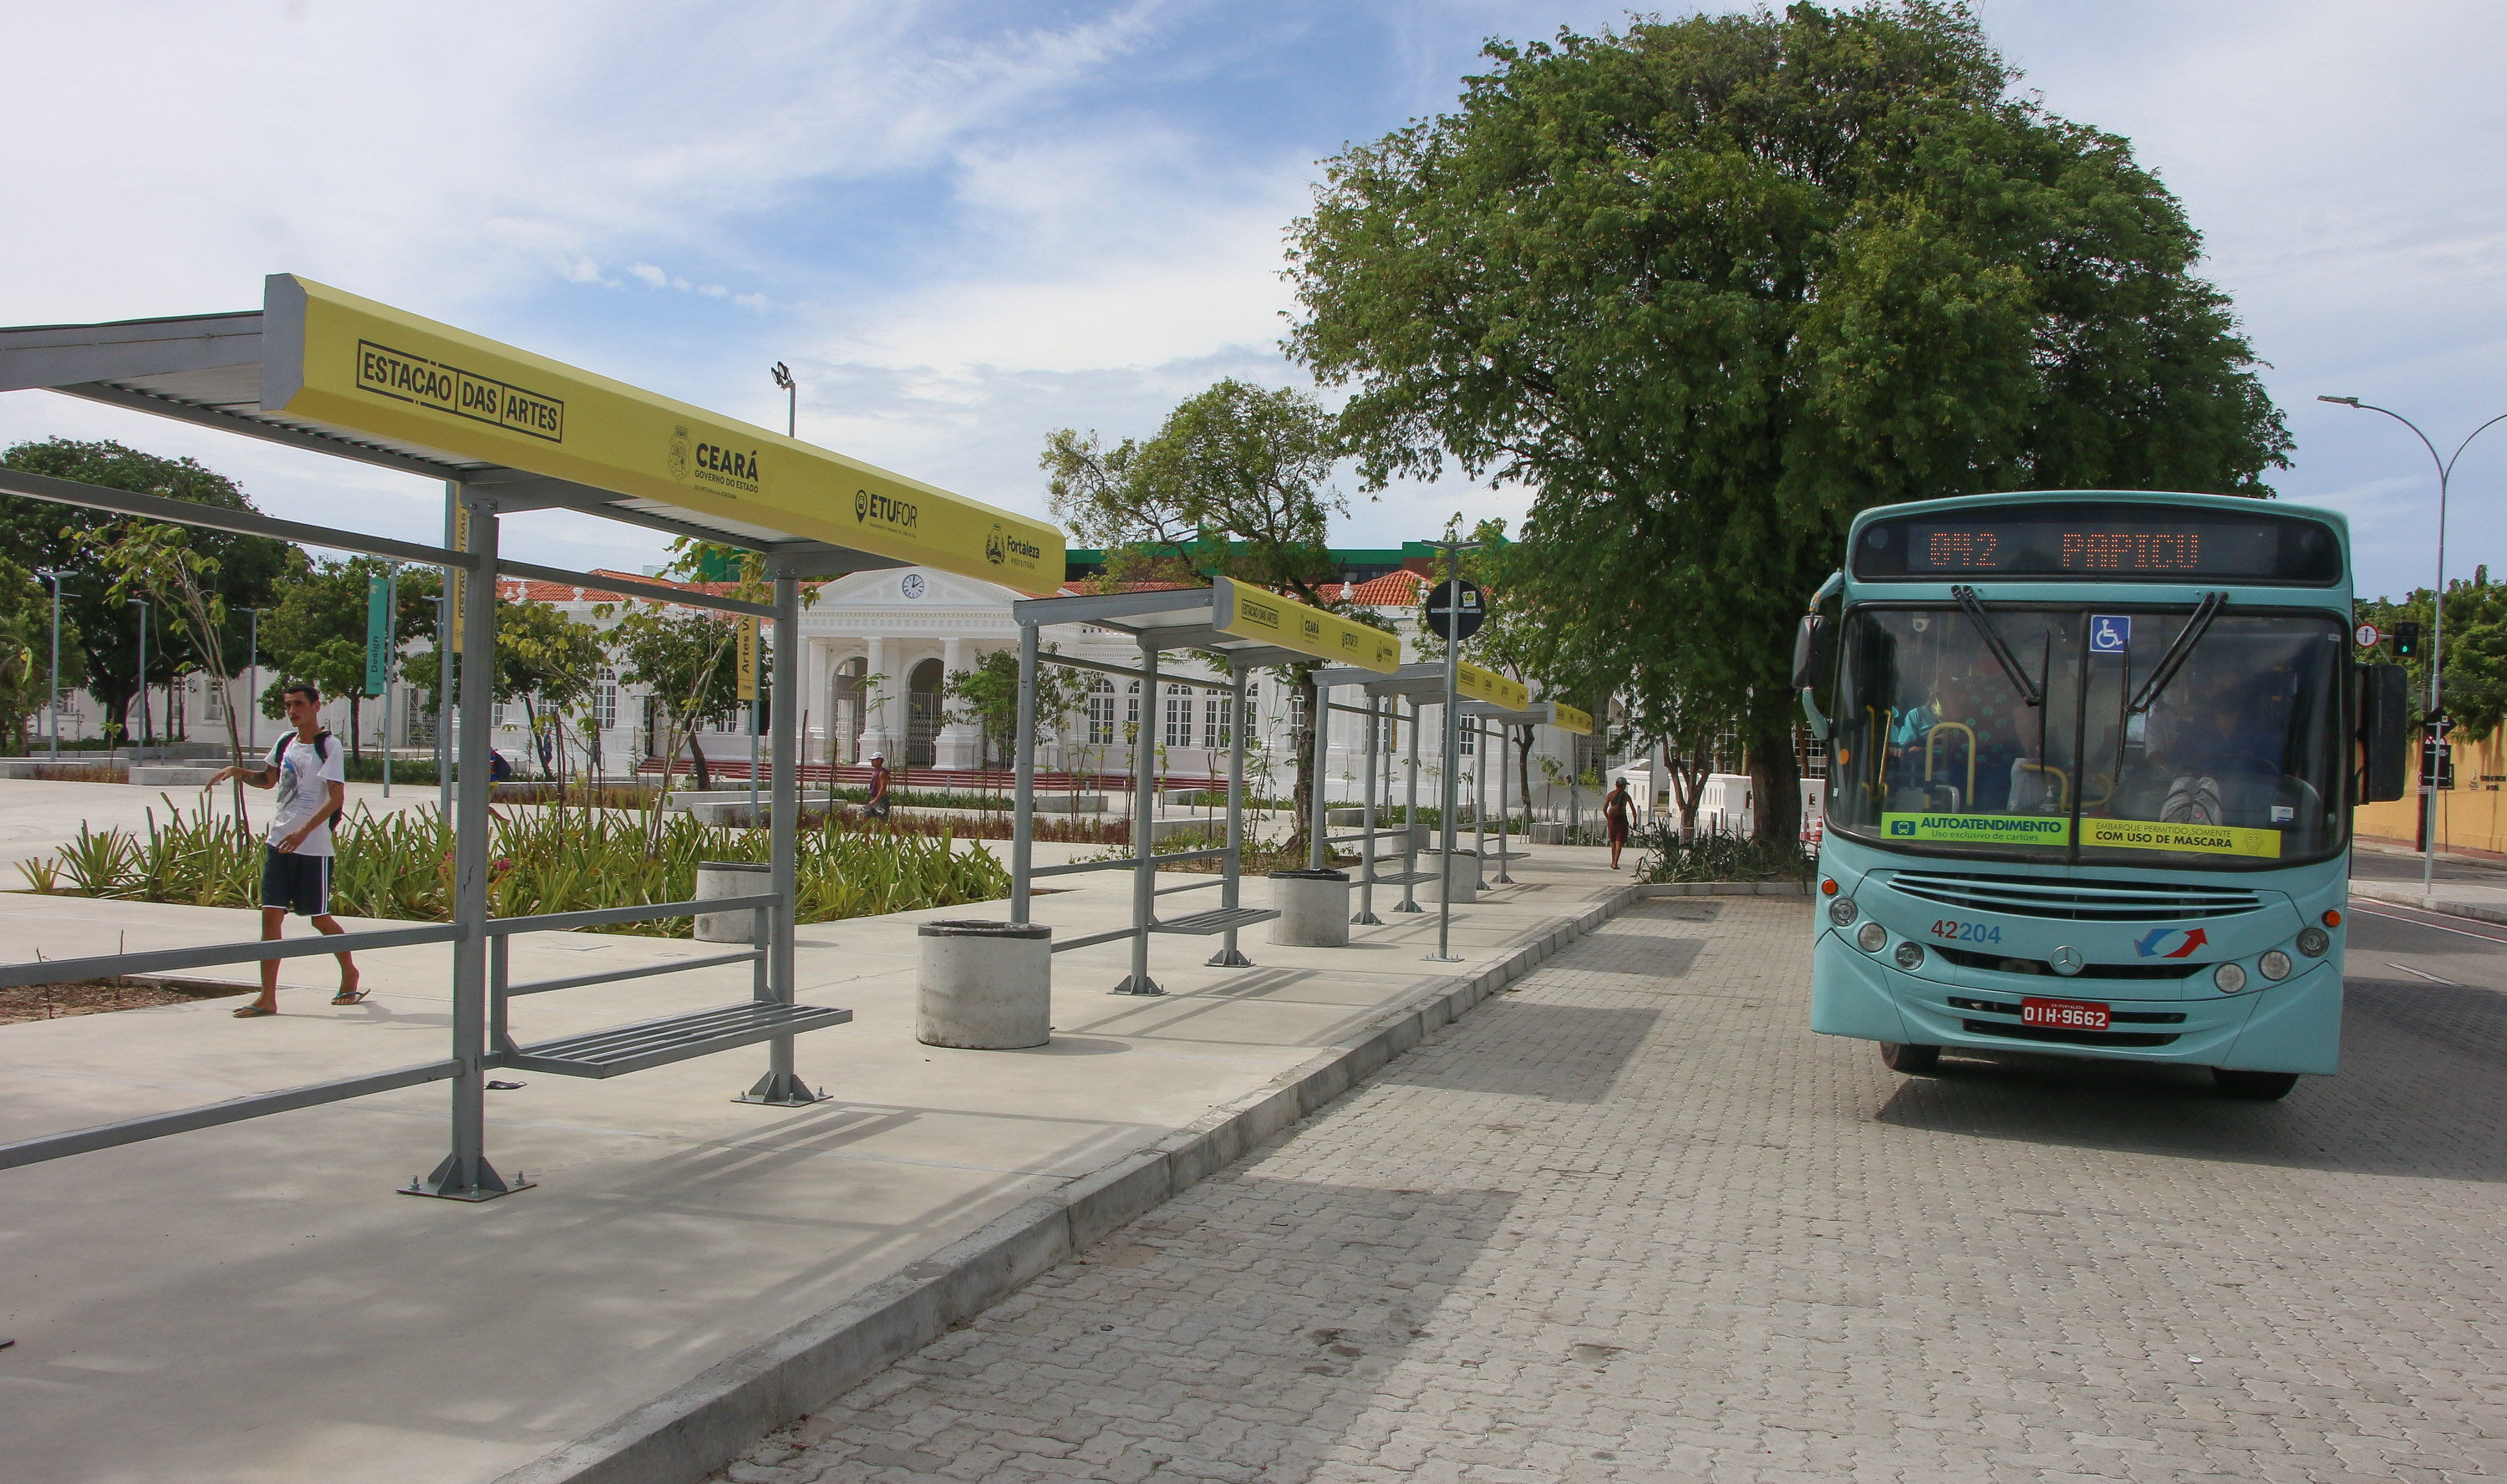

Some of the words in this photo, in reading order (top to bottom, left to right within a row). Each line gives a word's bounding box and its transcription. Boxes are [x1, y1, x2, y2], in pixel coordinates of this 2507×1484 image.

[462, 381, 496, 414] DAS
[506, 396, 557, 431] ARTES
[696, 443, 759, 482] CEARÁ
[695, 470, 725, 485] GOVERNO
[726, 478, 735, 487] DO
[736, 480, 759, 493] ESTADO
[870, 493, 918, 529] ETUFOR
[1007, 535, 1040, 559] Fortaleza
[2063, 533, 2199, 567] PAPICU
[1011, 557, 1035, 570] PREFEITURA
[370, 636, 380, 673] Design
[741, 634, 750, 674] Artes
[1920, 817, 2062, 833] AUTOATENDIMENTO
[1931, 830, 1948, 838] Uso
[1950, 831, 1991, 840] exclusivo
[2006, 833, 2039, 841] cartões
[2096, 822, 2141, 832] EMBARQUE
[2190, 828, 2232, 838] SOMENTE
[2096, 831, 2123, 841] COM
[2127, 832, 2153, 843] USO
[2156, 834, 2170, 844] DE
[2174, 832, 2233, 848] MÁSCARA
[1931, 919, 2001, 944] 42204
